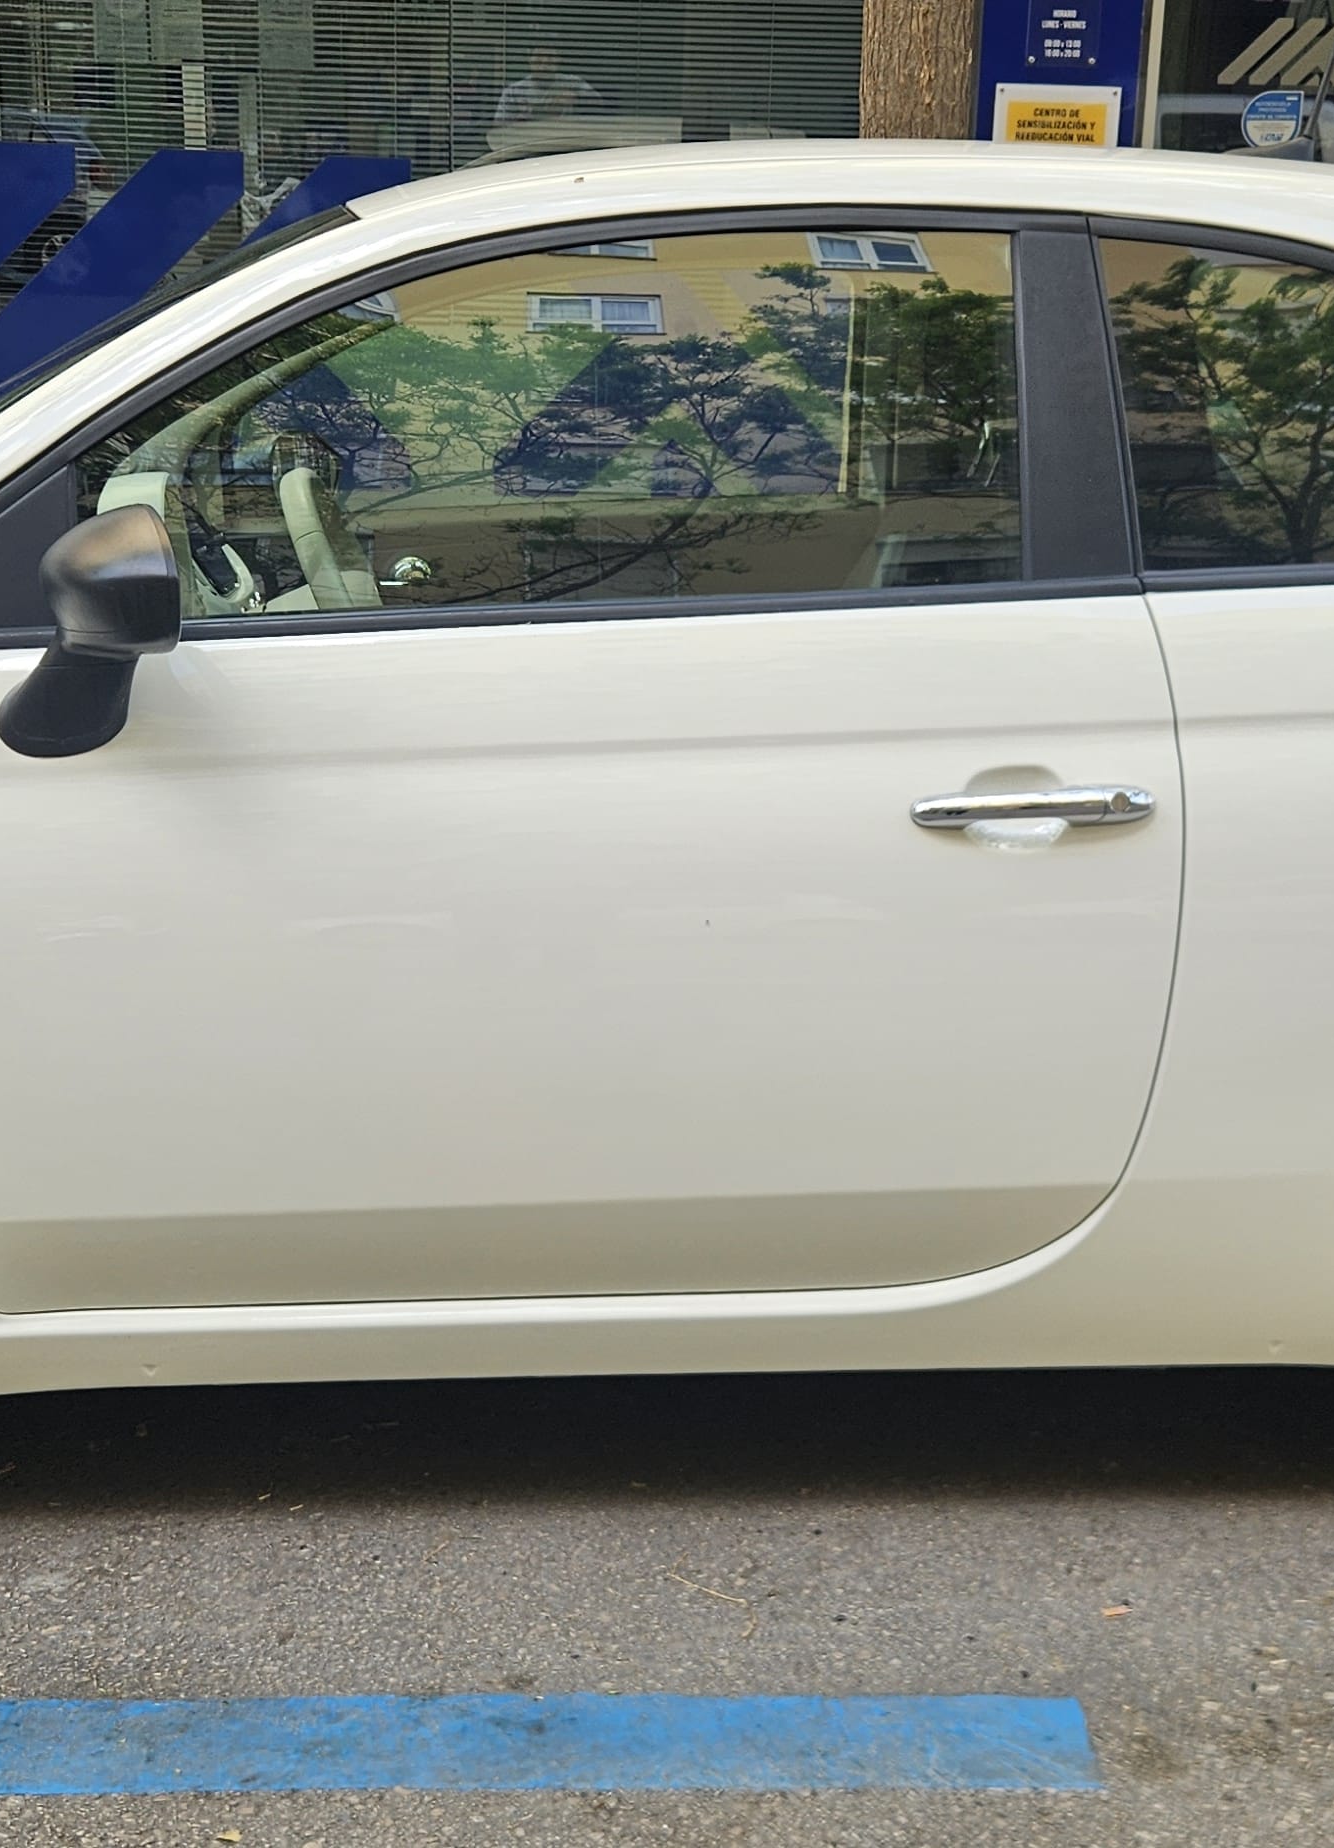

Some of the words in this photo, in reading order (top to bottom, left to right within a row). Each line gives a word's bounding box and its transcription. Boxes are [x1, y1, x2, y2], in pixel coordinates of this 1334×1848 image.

[1033, 107, 1067, 118] CENTRO
[1069, 108, 1080, 118] DE
[1016, 119, 1087, 130] SENSIBILIZACIÓN
[1089, 122, 1096, 130] Y
[1014, 131, 1074, 142] REEDUCACIÓN
[1076, 133, 1095, 142] VIAL
